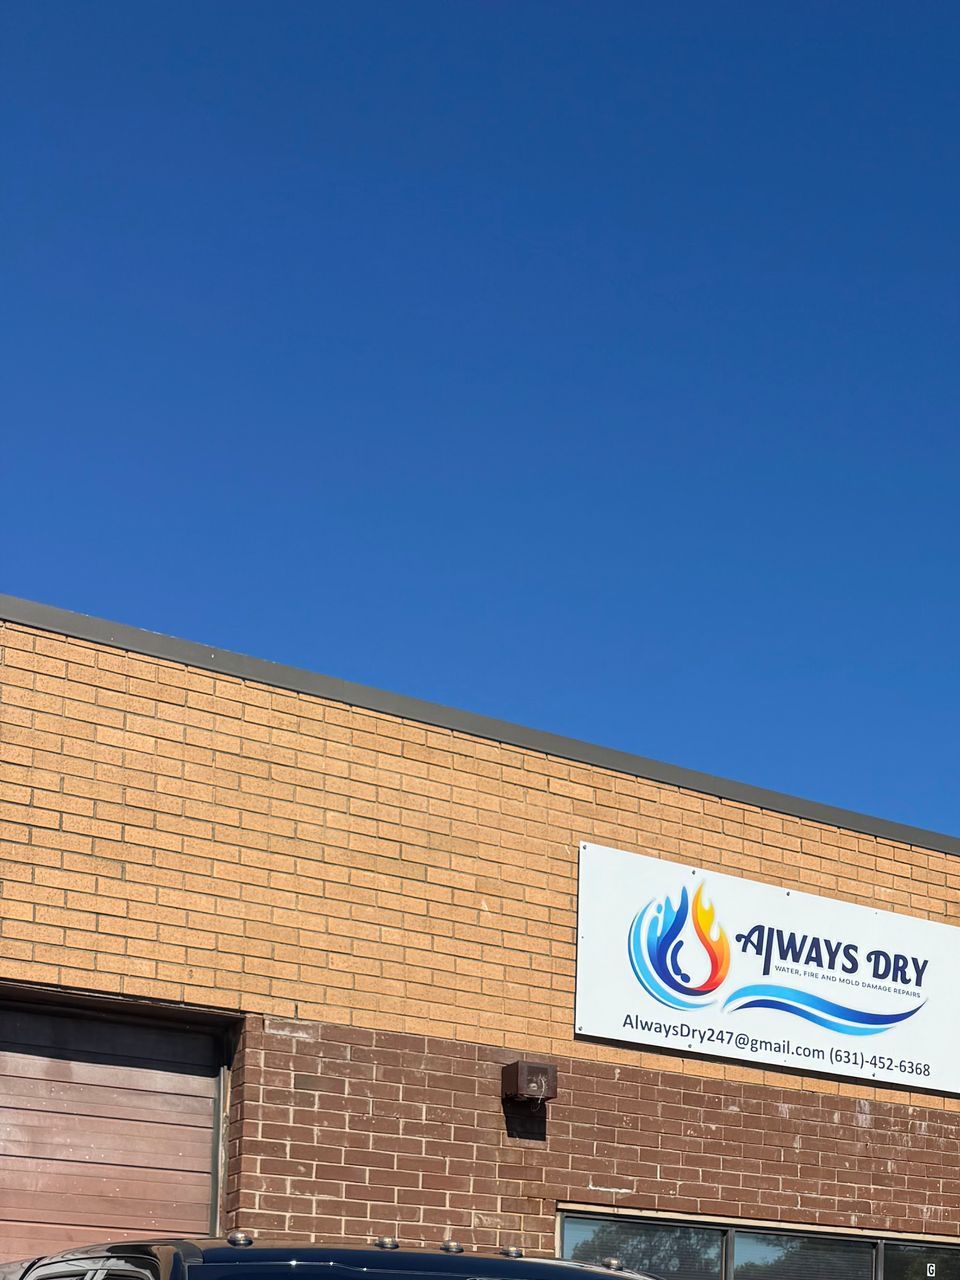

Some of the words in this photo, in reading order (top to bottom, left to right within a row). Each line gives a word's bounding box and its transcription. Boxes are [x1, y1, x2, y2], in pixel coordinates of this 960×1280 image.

[774, 965, 801, 976] WATER,
[803, 970, 819, 979] FIRE
[821, 974, 837, 982] AND
[839, 977, 860, 986] MOLD
[862, 981, 892, 993] DAMAGE
[893, 988, 921, 998] REPAIRS
[866, 950, 929, 987] DRY
[622, 1013, 825, 1061] AlwaysDry247@gmail.com
[829, 1048, 931, 1077] (631)-452-6368
[928, 1264, 935, 1275] G
